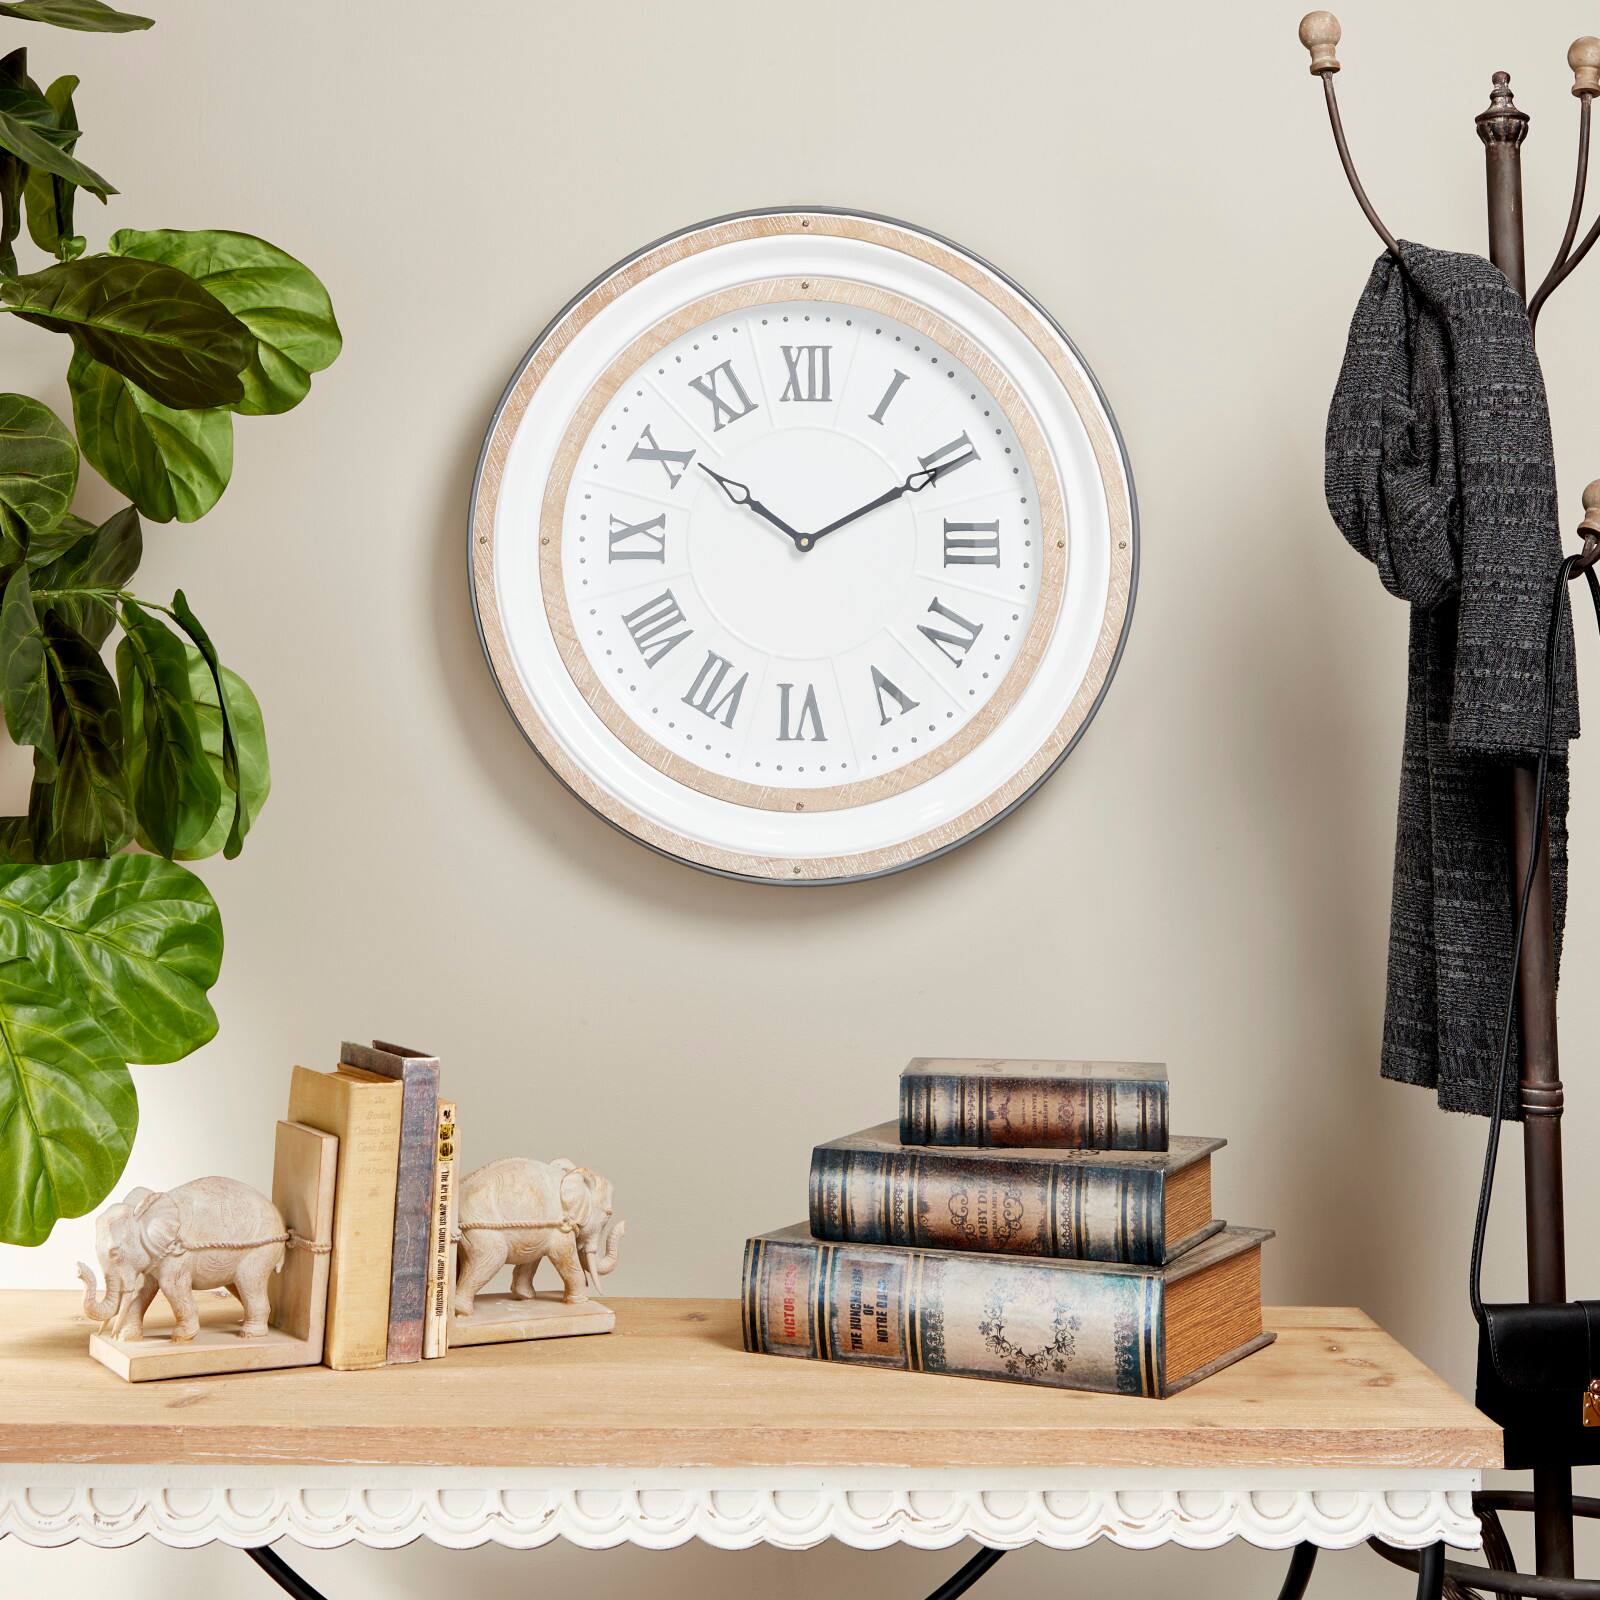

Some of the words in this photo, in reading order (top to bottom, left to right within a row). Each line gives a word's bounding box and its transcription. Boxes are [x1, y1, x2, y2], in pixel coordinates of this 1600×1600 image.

[687, 359, 760, 432] XI
[779, 344, 833, 402] XII
[867, 368, 911, 426] I
[627, 423, 697, 489] X
[917, 430, 982, 489] II
[608, 512, 667, 565] IX
[942, 517, 1001, 569] III
[620, 587, 695, 670] VIII
[916, 596, 985, 669] IV
[680, 649, 750, 730] VII
[775, 682, 829, 742] VI
[869, 663, 921, 727] V
[439, 1203, 449, 1226] Jewish
[783, 1296, 797, 1338] VICTOR
[863, 1303, 875, 1316] OF
[876, 1311, 889, 1343] NOTRE
[851, 1331, 864, 1351] THE
